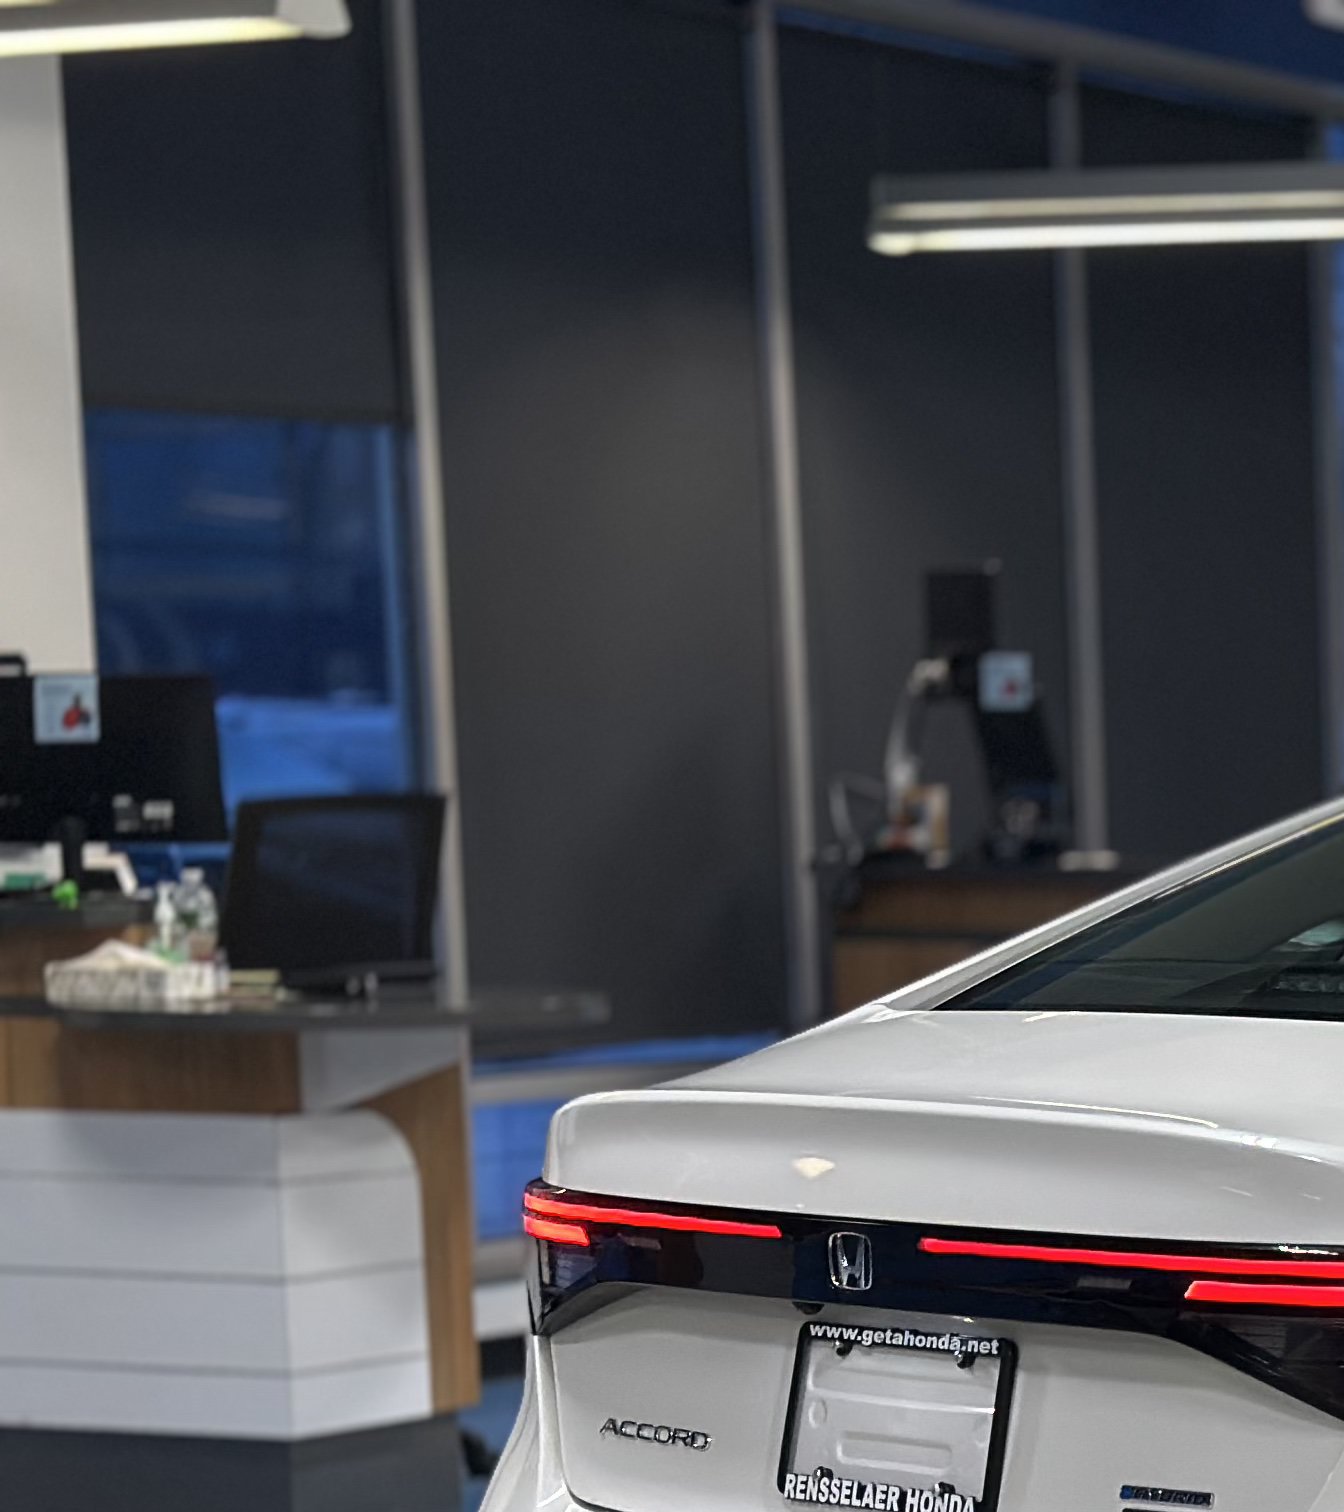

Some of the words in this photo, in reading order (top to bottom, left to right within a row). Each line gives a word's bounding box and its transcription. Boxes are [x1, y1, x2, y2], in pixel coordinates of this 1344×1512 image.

[809, 1323, 1000, 1355] www.getahonda.net
[600, 1418, 711, 1451] ACCORD
[784, 1473, 900, 1512] RENSSELAER
